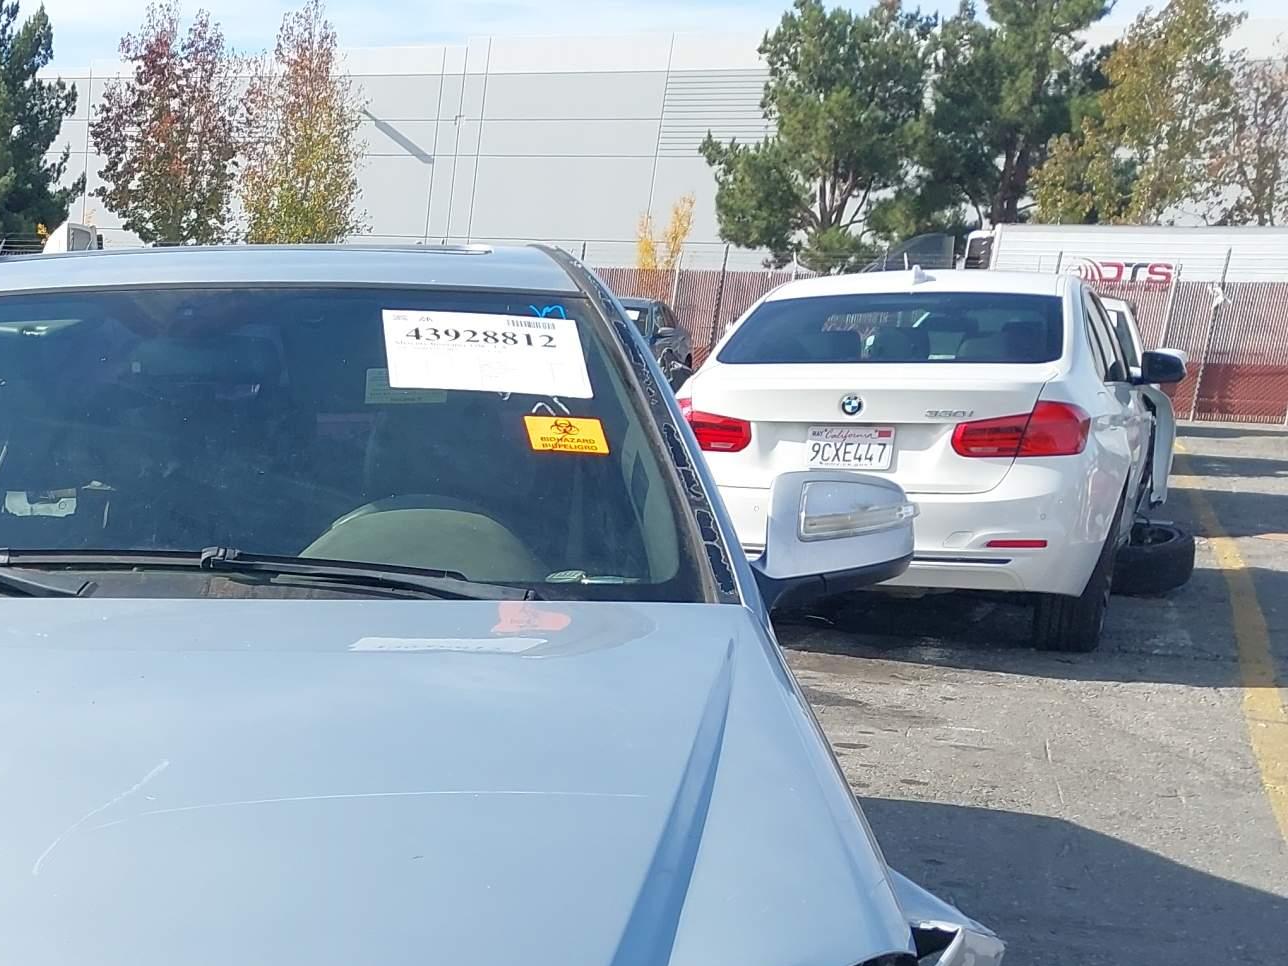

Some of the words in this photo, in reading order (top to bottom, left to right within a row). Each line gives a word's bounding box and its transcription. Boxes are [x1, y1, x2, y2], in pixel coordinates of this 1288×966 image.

[1098, 262, 1173, 284] DTS
[406, 327, 557, 348] 43928812
[540, 436, 596, 444] BIOHAZARD
[825, 428, 874, 442] California
[542, 443, 598, 451] BIOPELIGRO
[810, 442, 887, 463] 9CXE447
